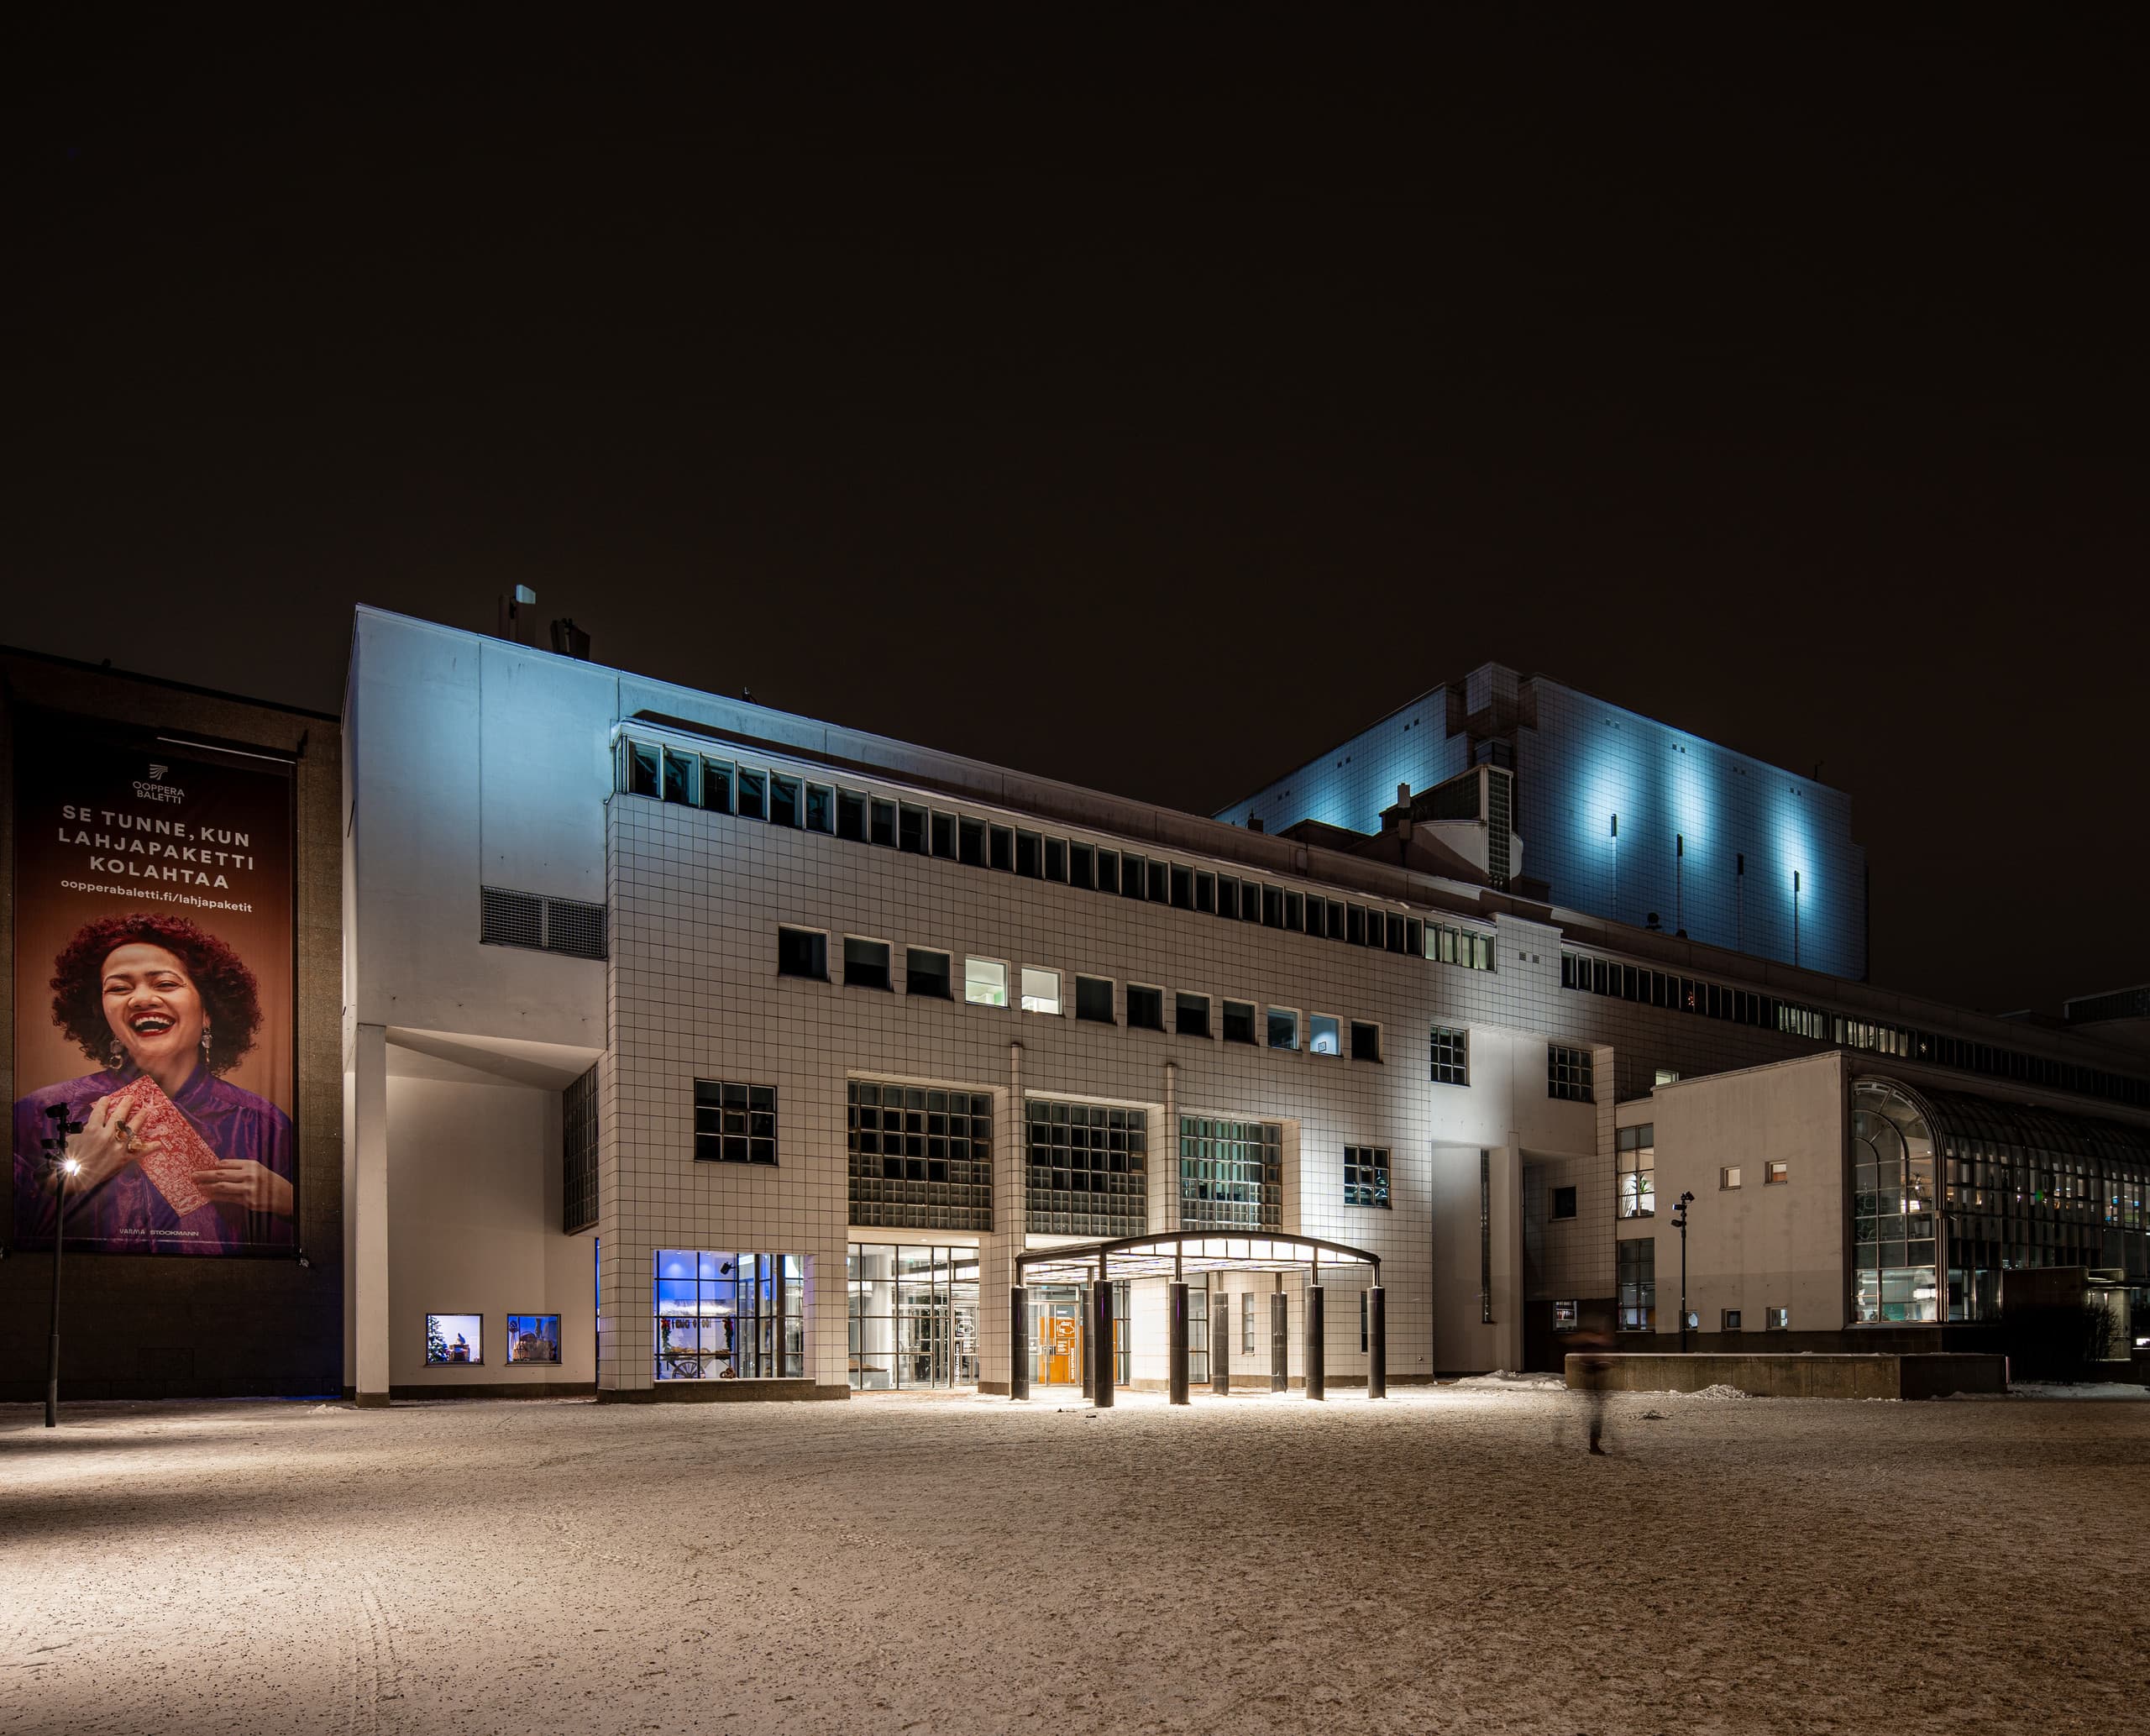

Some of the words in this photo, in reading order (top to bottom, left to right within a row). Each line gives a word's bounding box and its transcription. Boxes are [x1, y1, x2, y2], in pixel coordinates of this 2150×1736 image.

[133, 781, 185, 797] OOPPERA
[137, 790, 181, 805] BALETTI
[62, 805, 92, 822] SE
[101, 810, 195, 841] TUNNE,
[201, 826, 249, 847] KUN
[58, 827, 254, 870] LAHJAPAKETTI
[90, 856, 229, 889] KOLAHTAA
[60, 879, 253, 913] oopperabaletti.fi/lahjapaketit
